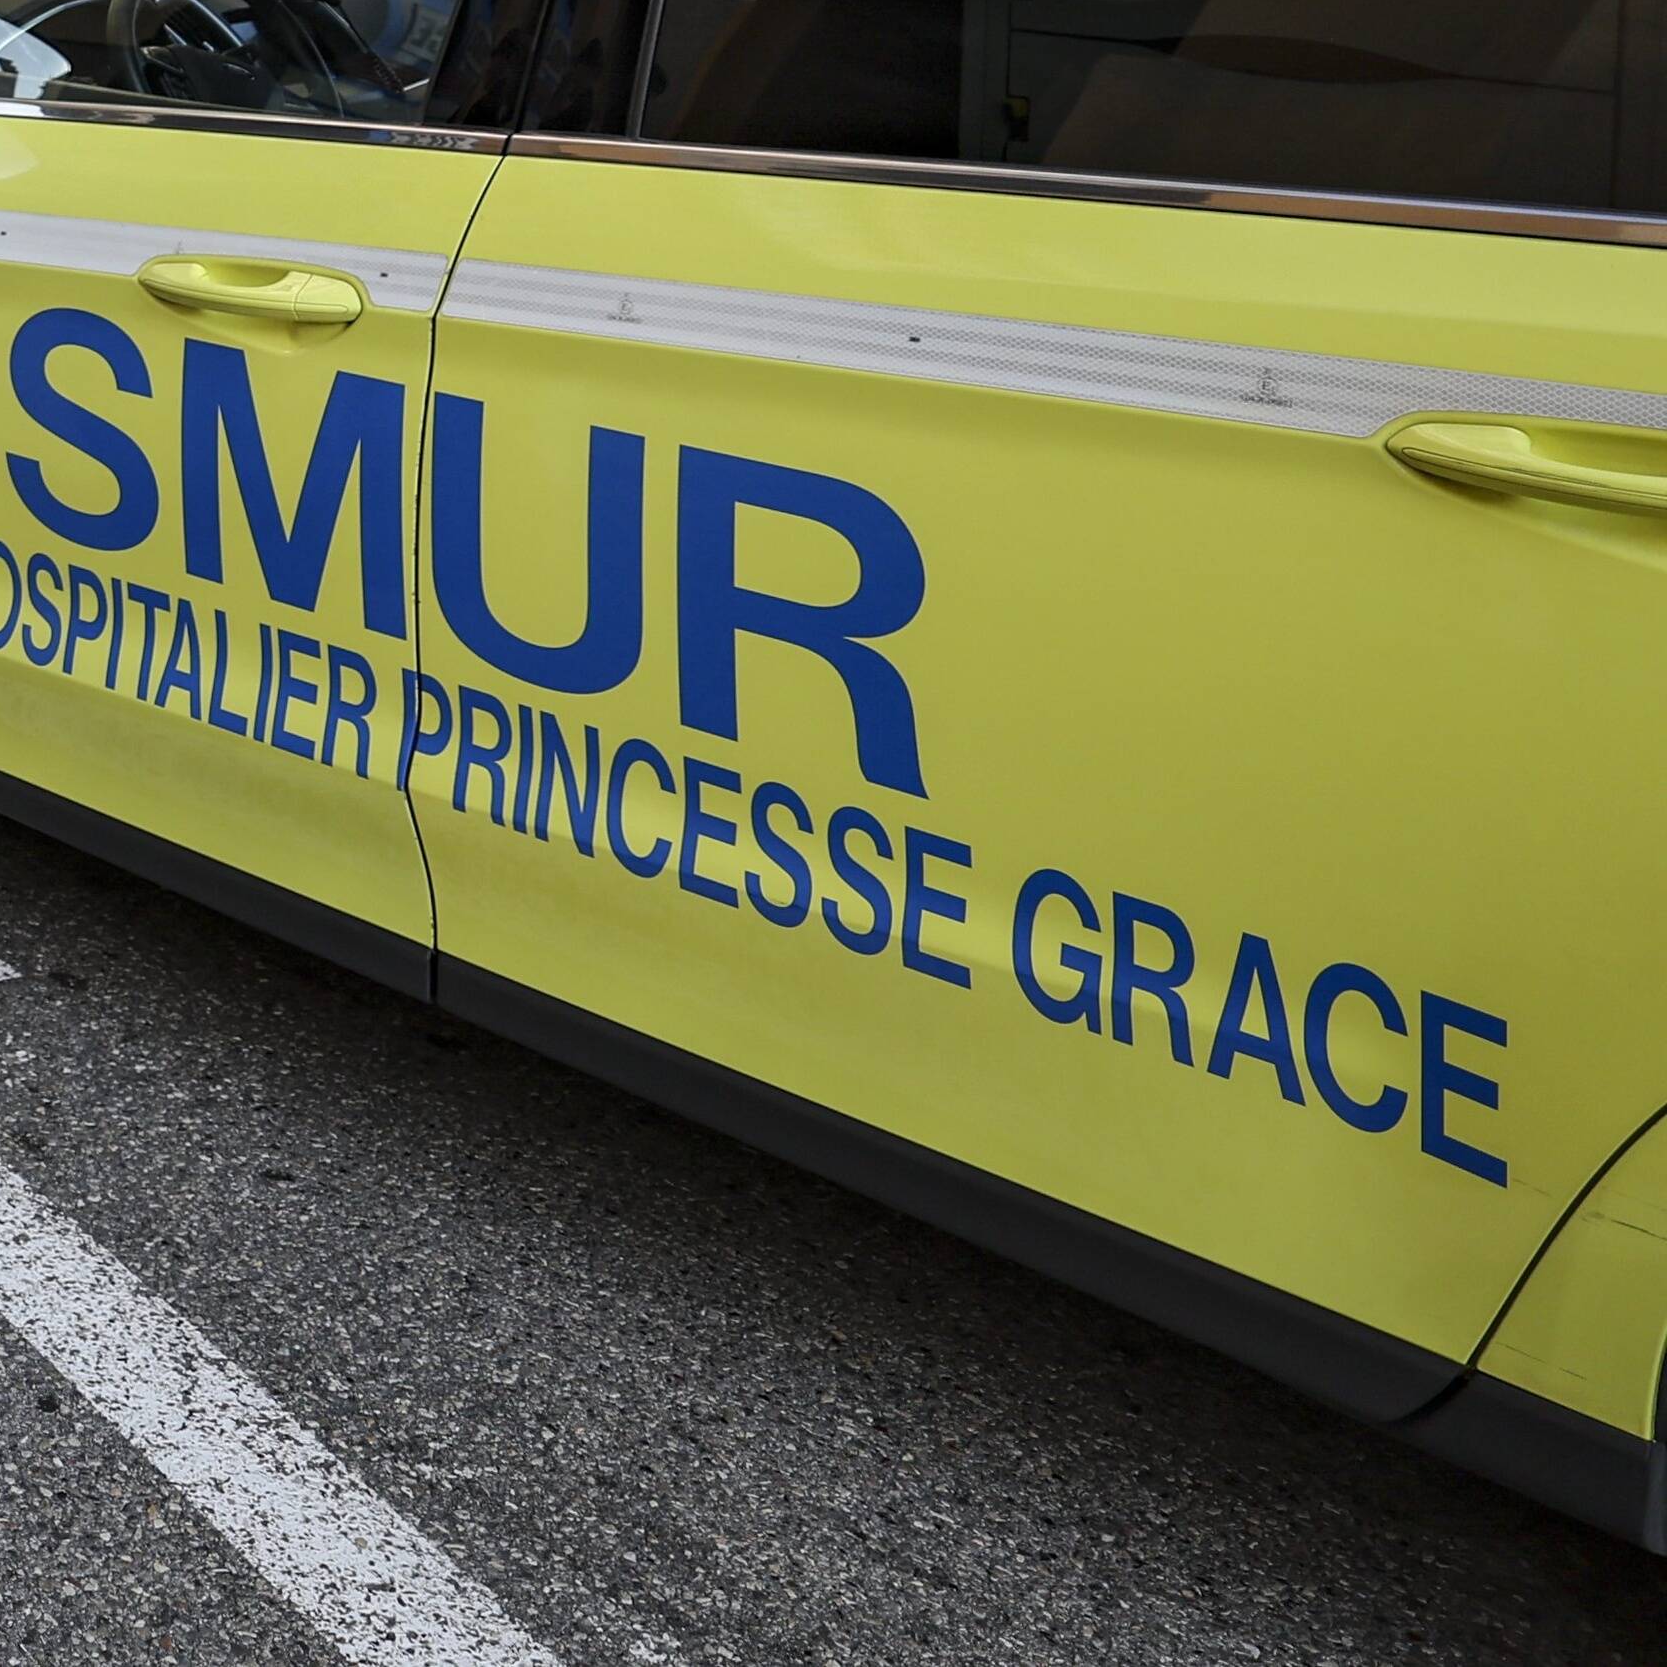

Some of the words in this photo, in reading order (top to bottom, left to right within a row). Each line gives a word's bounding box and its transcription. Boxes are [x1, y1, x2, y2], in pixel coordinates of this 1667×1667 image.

[5, 307, 928, 800] SMUR
[398, 667, 973, 989] PRINCESSE
[1012, 868, 1509, 1187] GRACE
